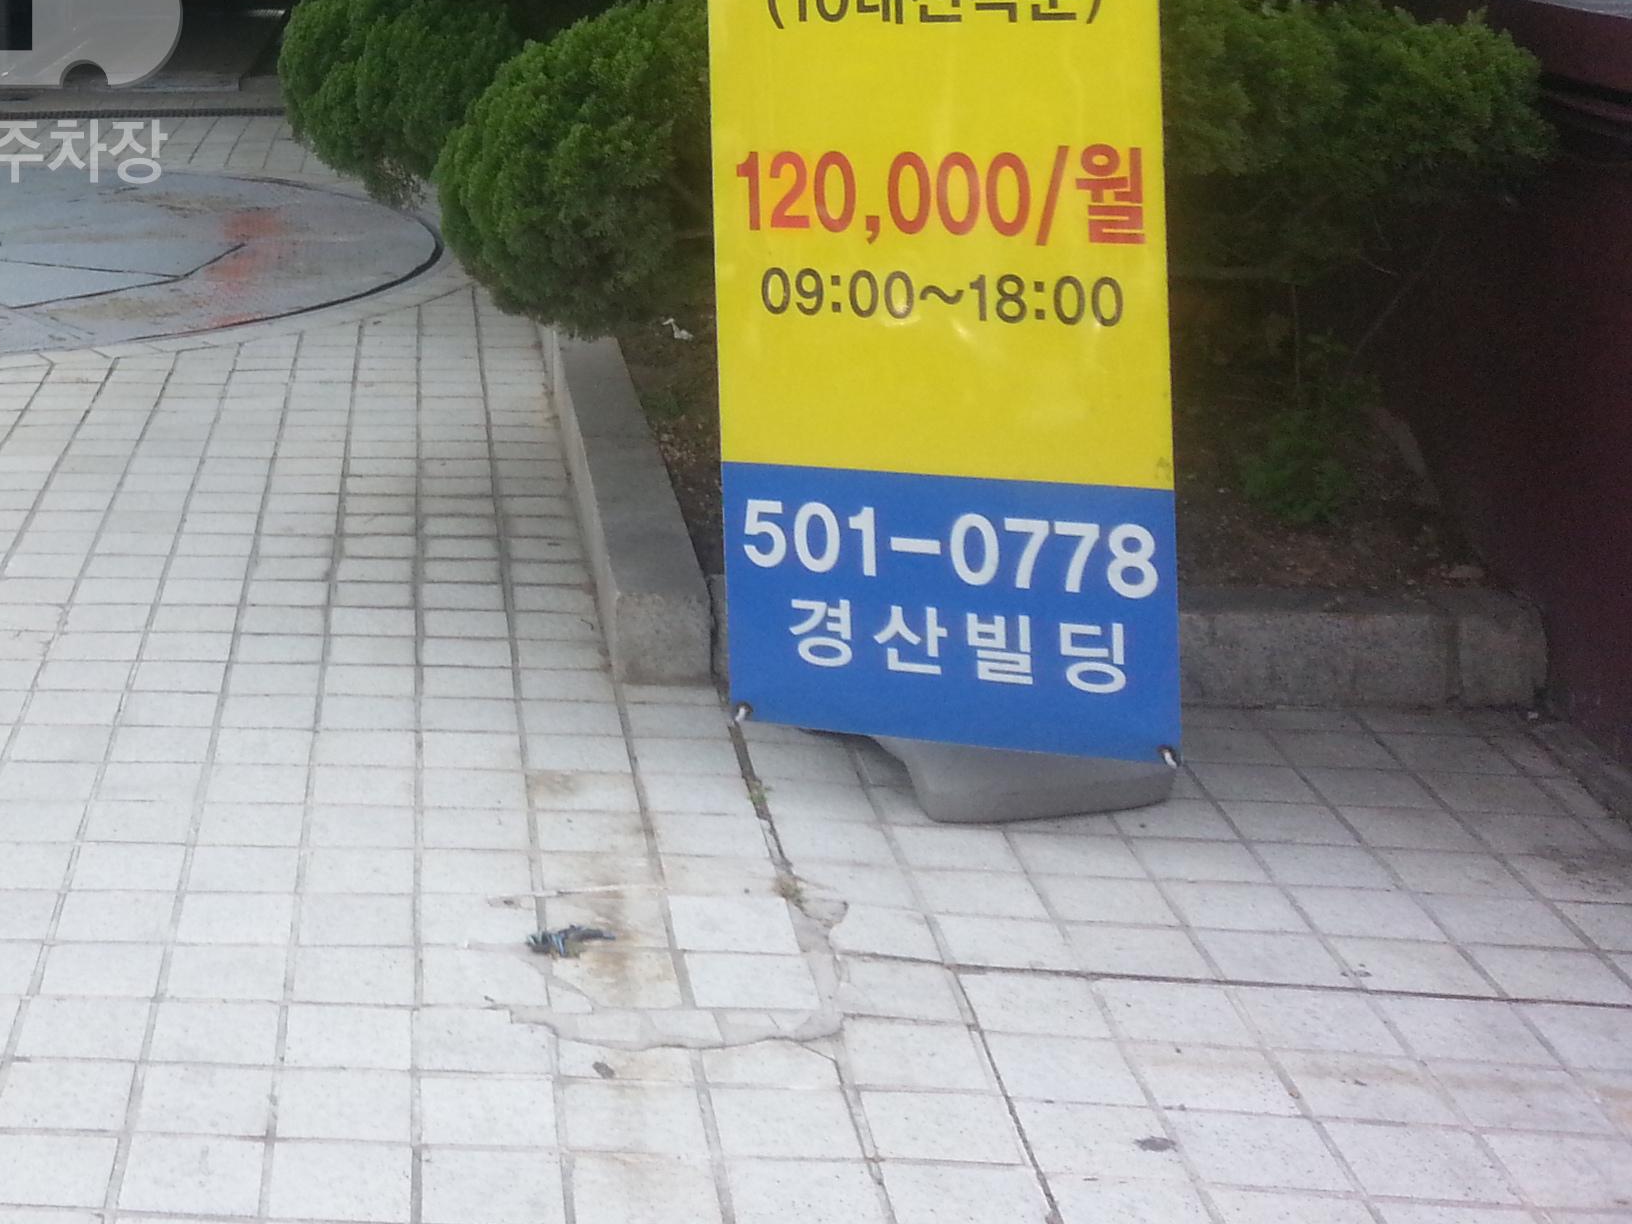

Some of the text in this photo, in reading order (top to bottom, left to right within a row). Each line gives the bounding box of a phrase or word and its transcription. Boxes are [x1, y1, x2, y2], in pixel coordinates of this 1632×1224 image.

[736, 143, 1147, 246] 120,000/월
[761, 266, 1124, 328] 09:00~18:00
[743, 498, 1159, 599] 501-0778
[788, 597, 1128, 694] 경산빌딩
